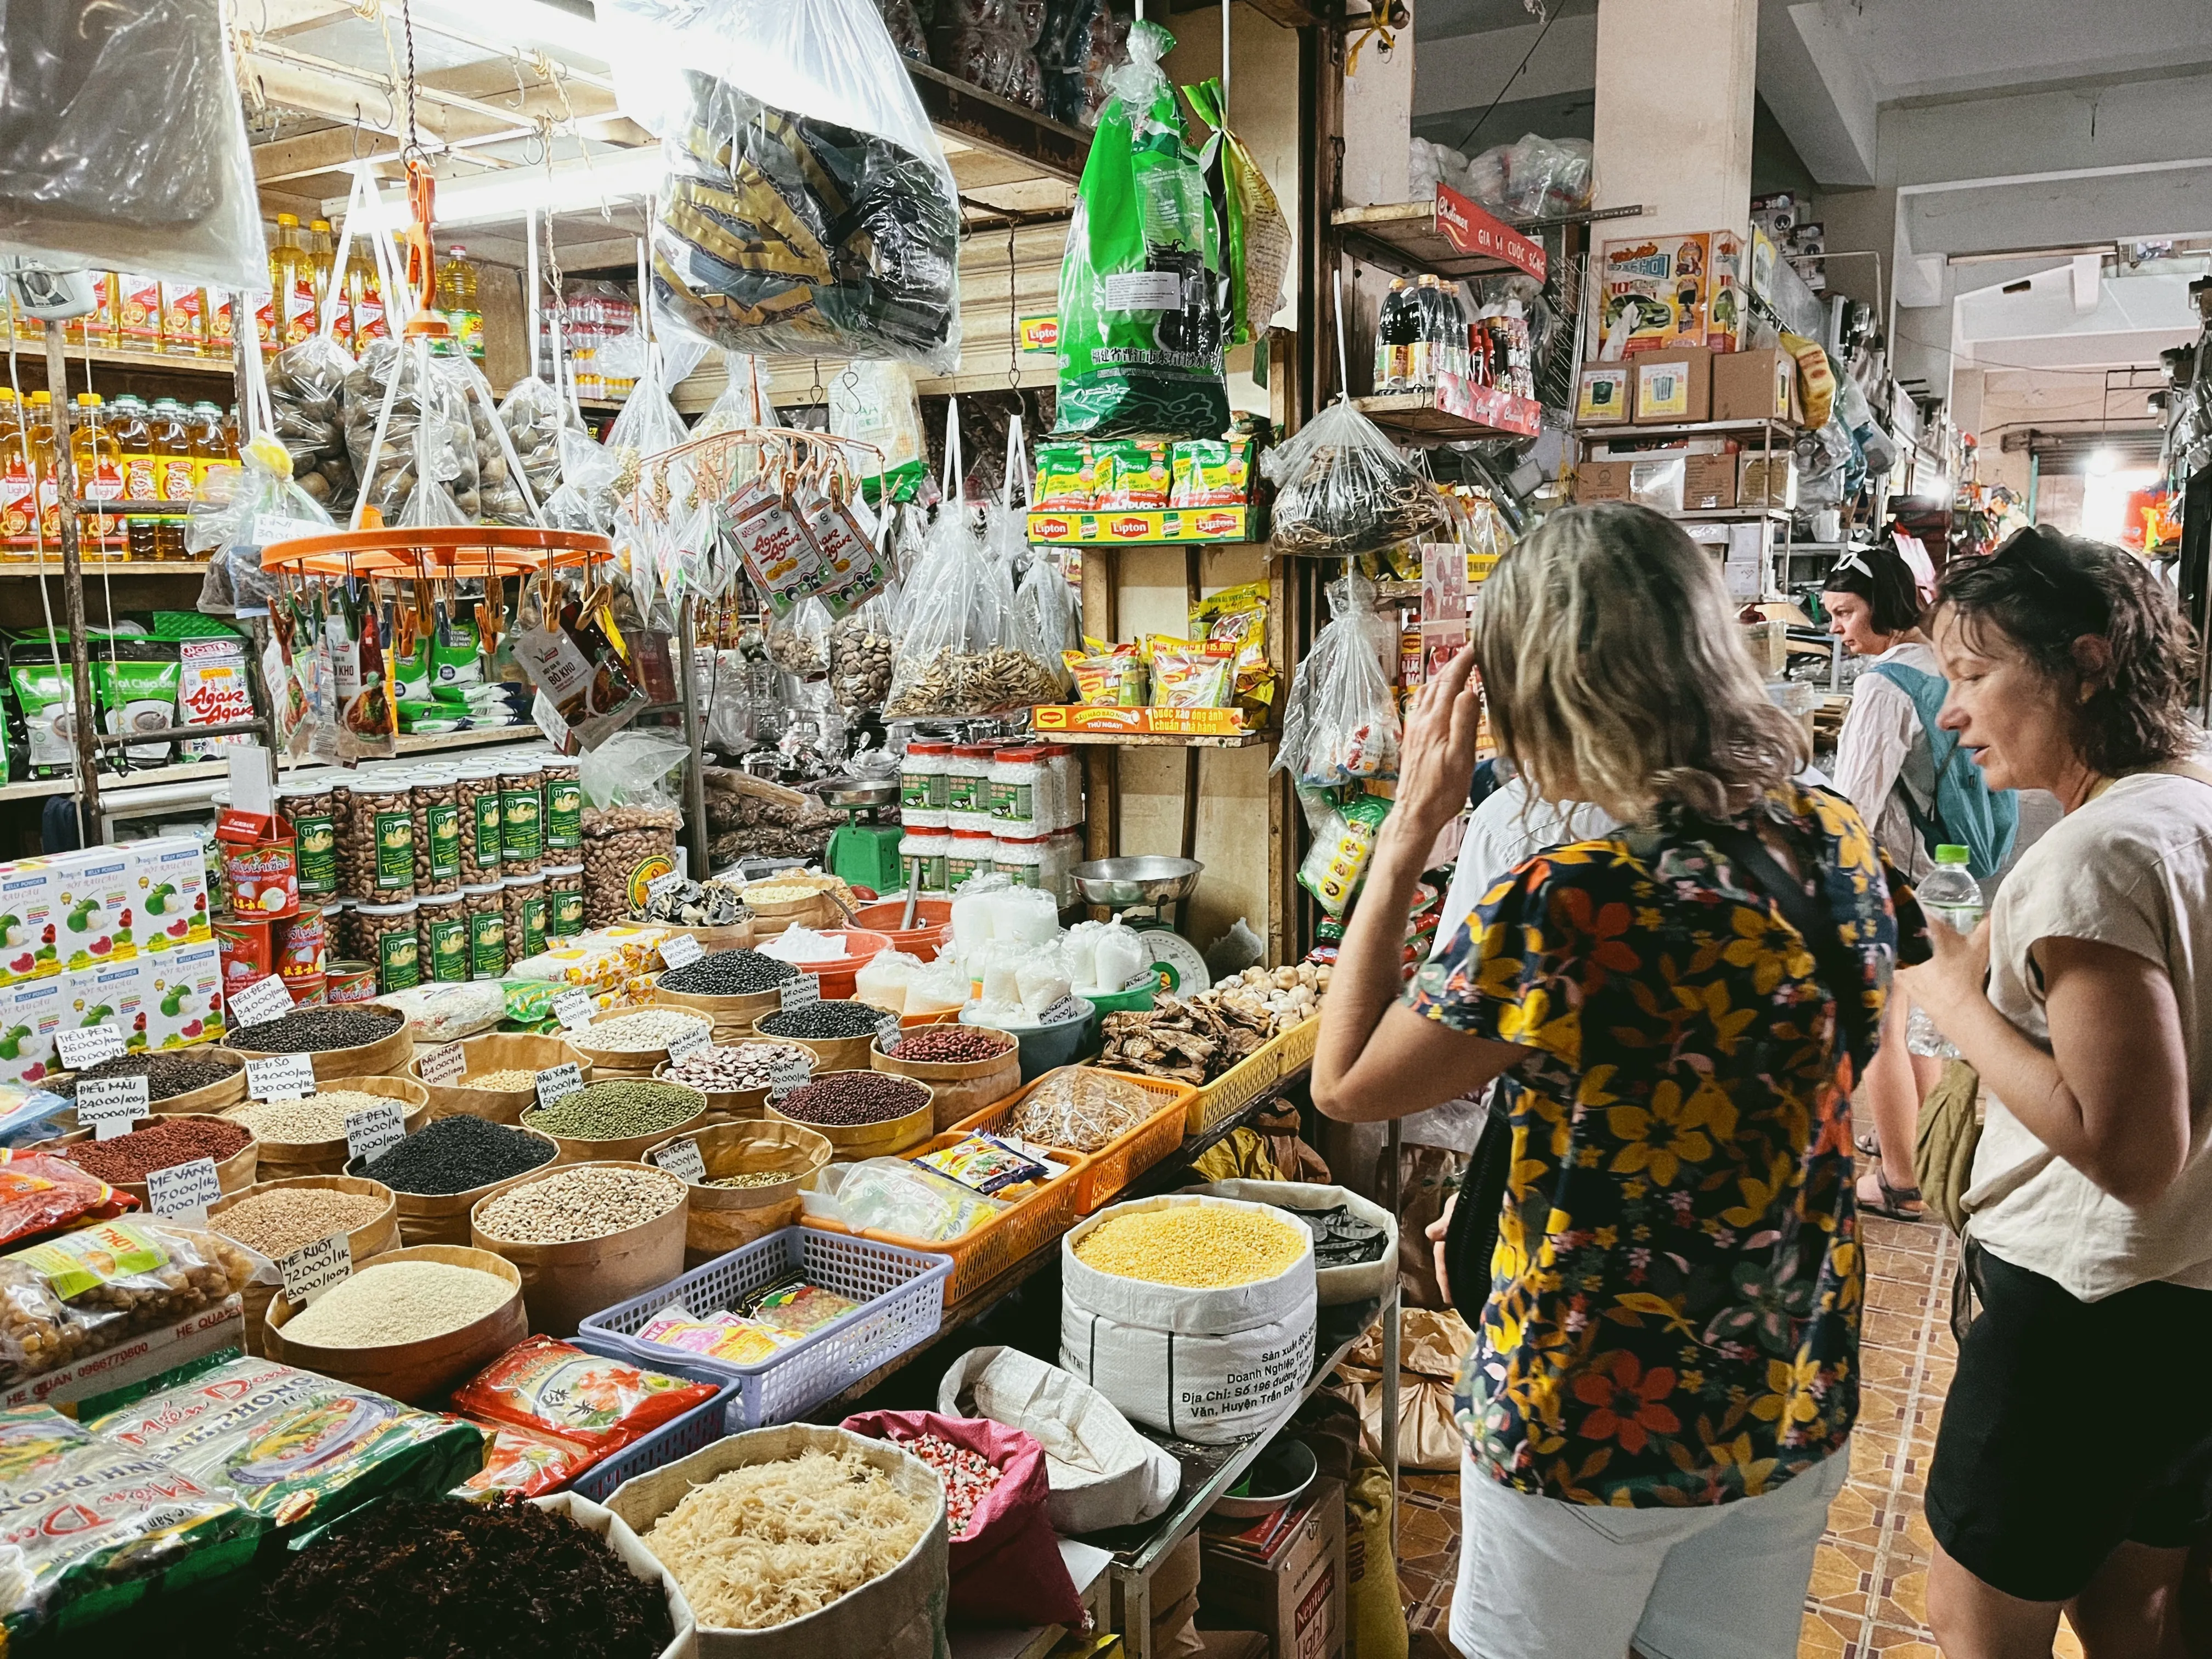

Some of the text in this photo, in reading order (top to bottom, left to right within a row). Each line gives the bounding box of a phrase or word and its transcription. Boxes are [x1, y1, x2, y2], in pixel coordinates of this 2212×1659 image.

[1479, 229, 1491, 247] GIA
[1034, 523, 1066, 535] Lipton
[1112, 523, 1147, 536] Lipton
[1197, 518, 1235, 531] Lipton
[752, 526, 789, 555] Agar
[760, 533, 802, 565] Agar
[338, 665, 354, 676] KHO
[561, 661, 576, 679] KHO
[185, 686, 245, 714] Agar
[188, 704, 254, 726] Agar
[1153, 708, 1223, 722] bước xào óng ánh
[1154, 720, 1217, 733] chuẩn nhà hàng
[176, 851, 197, 859] POWDER
[101, 865, 123, 873] POWDER
[4, 878, 44, 890] JELLY POWDER
[193, 952, 213, 960] POWDER
[115, 969, 138, 978] POWDER
[32, 989, 56, 997] POWDER
[176, 1322, 194, 1339] HE
[1262, 1351, 1280, 1363] Sản
[1227, 1368, 1262, 1384] Doanh
[1265, 1358, 1295, 1375] Nghiệp
[1182, 1368, 1297, 1406] Địa Chỉ: Số 196 đường
[6, 1389, 27, 1406] HE
[1191, 1390, 1282, 1418] Văn, Huyện Trần
